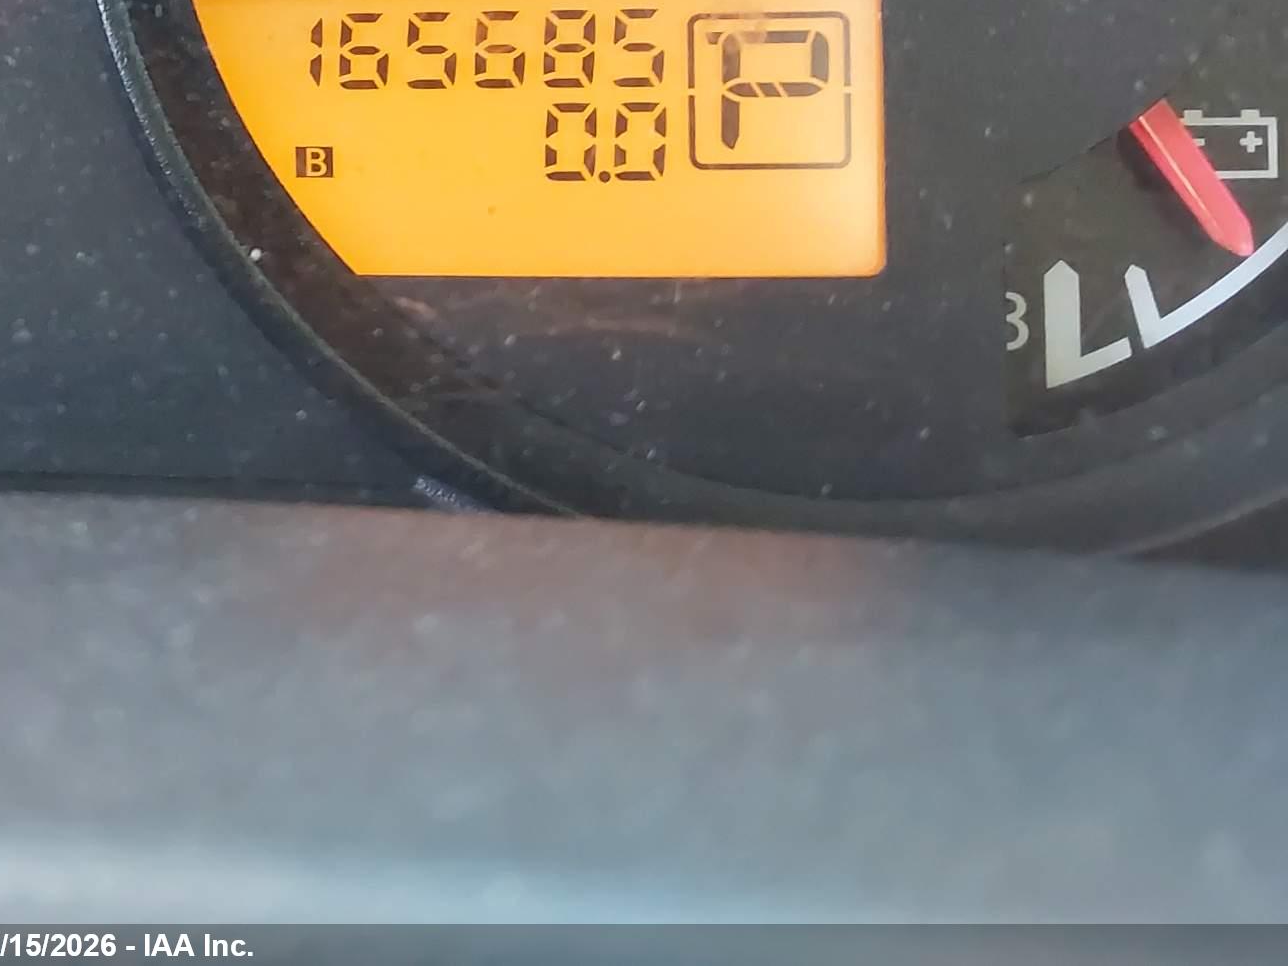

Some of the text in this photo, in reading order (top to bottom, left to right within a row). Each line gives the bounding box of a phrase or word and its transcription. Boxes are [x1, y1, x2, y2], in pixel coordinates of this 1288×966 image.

[309, 8, 665, 90] 165685
[706, 29, 830, 151] P
[301, 147, 331, 177] B
[544, 102, 667, 181] 0.0
